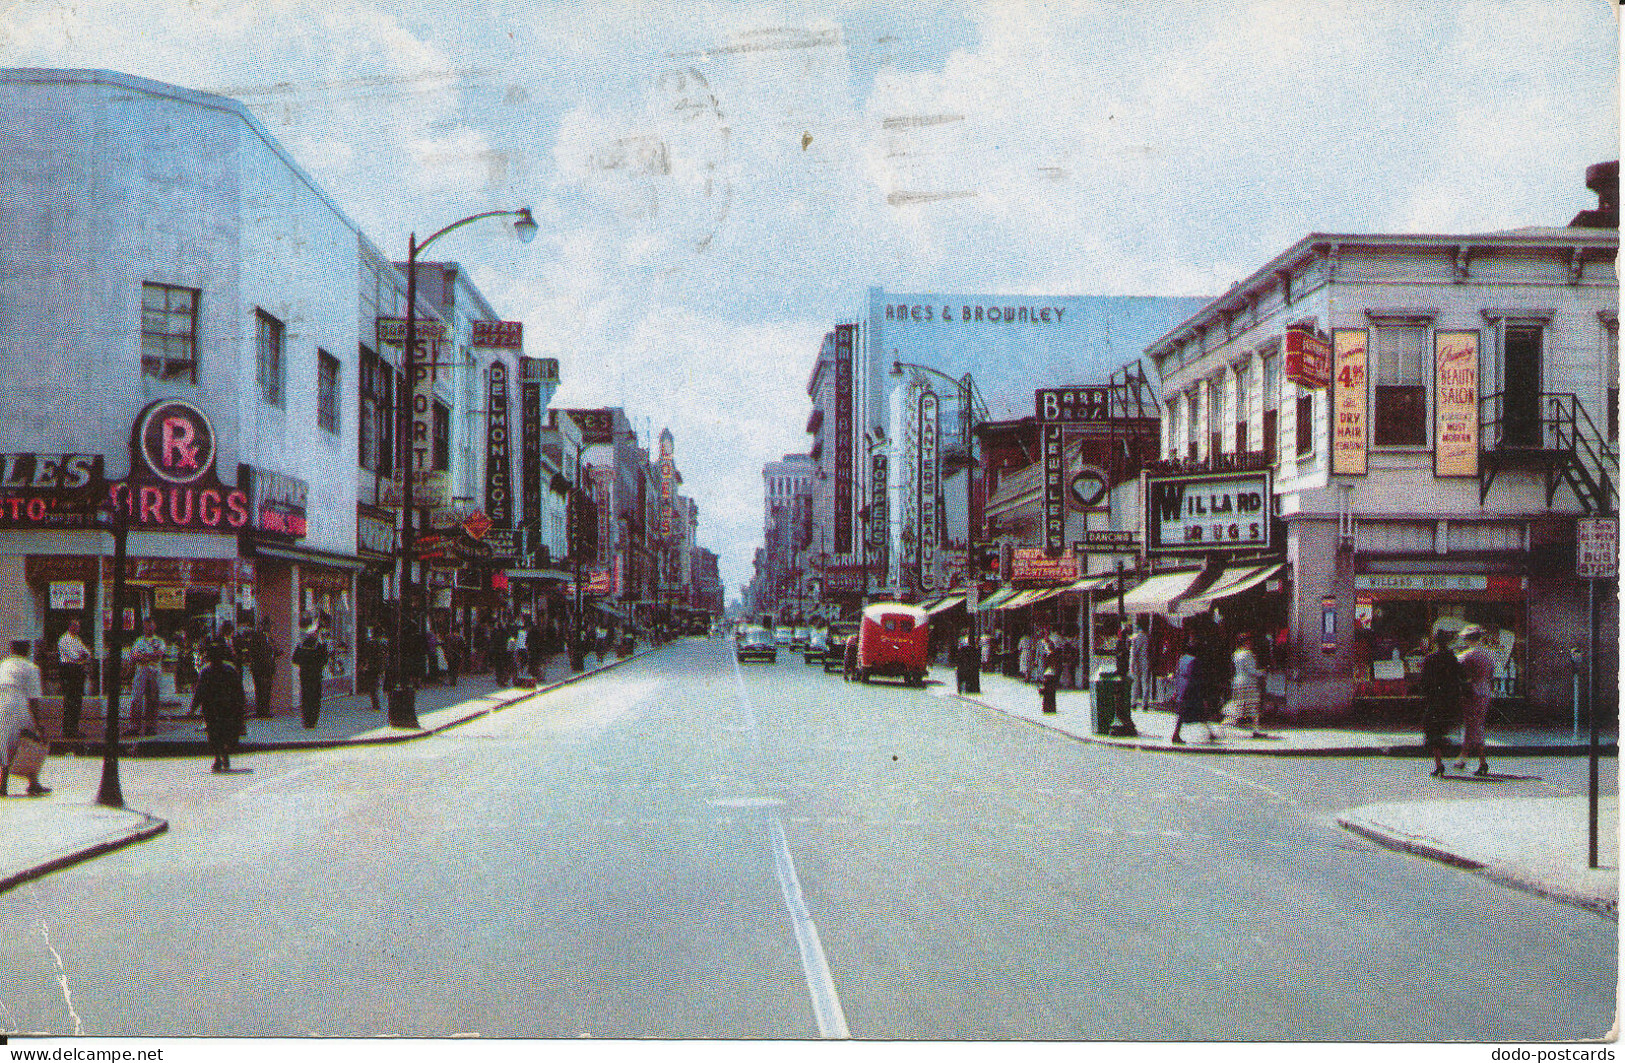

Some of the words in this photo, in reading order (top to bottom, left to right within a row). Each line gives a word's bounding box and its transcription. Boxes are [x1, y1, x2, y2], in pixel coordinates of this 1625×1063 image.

[886, 304, 933, 322] AMES
[962, 304, 1066, 323] BROWNLEY
[412, 339, 428, 469] SPORT
[923, 400, 934, 496] PLANTERS
[874, 456, 886, 546] TOPPERS
[1048, 427, 1060, 547] JEWELERS
[1159, 483, 1262, 521] WILLARD
